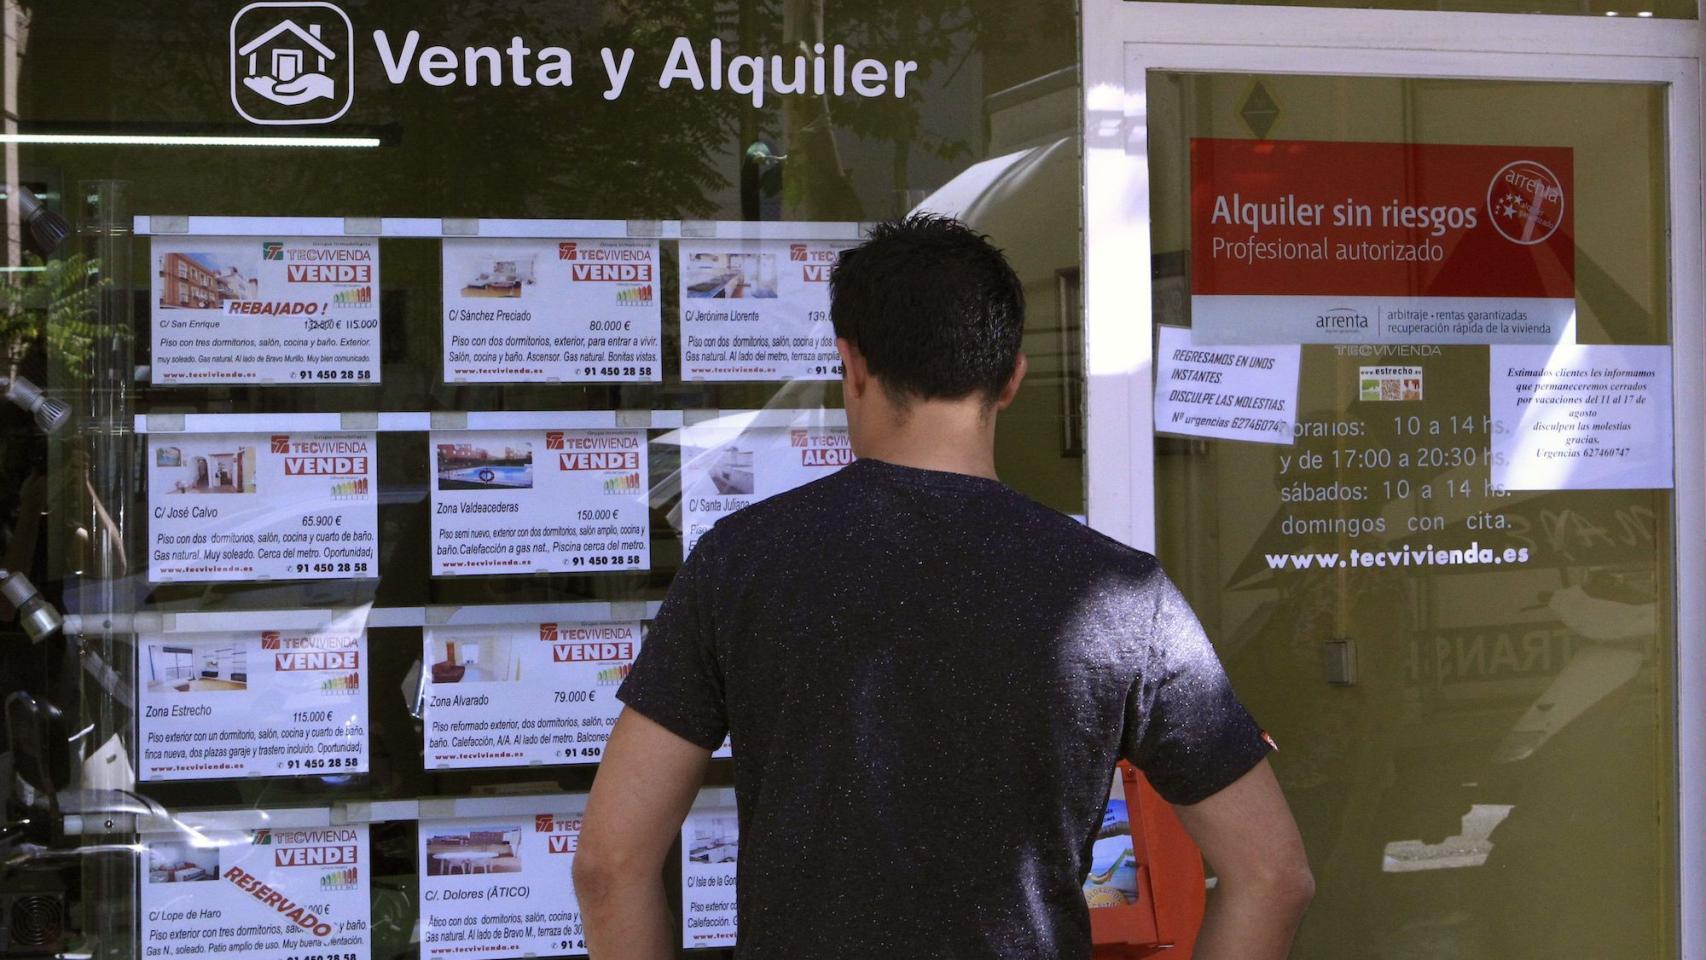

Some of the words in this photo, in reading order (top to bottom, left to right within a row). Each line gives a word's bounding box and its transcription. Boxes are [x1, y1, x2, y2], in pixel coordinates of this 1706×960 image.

[373, 29, 573, 87] Venta
[600, 47, 635, 100] y
[658, 36, 918, 109] Alquiler
[1212, 194, 1323, 233] Alquiler
[1333, 198, 1371, 226] sin
[1382, 200, 1476, 235] riesgos
[287, 249, 370, 261] TECVIVIENDA
[579, 250, 651, 260] TECVIVIENDA
[1213, 236, 1328, 262] Profesional
[1336, 239, 1444, 262] autorizado
[288, 265, 370, 282] VENDE
[573, 265, 650, 280] VENDE
[229, 302, 317, 315] REBAJADO
[460, 309, 494, 321] Sánchez
[496, 310, 531, 321] Preciado
[695, 309, 728, 321] Jerónima
[730, 311, 759, 321] Llorente
[1316, 315, 1367, 327] arrenta
[1387, 309, 1428, 321] arbitraje
[1435, 311, 1464, 320] rentas
[1467, 311, 1528, 323] garantizadas
[172, 320, 187, 328] San
[189, 320, 220, 329] Enrique
[336, 320, 341, 329] €
[346, 319, 377, 329] 115.000
[590, 321, 621, 331] 80.000
[624, 321, 630, 330] €
[1388, 322, 1449, 334] recuperación
[1452, 322, 1482, 334] rápida
[1485, 322, 1497, 333] de
[1500, 322, 1508, 332] la
[1511, 323, 1550, 333] vivienda
[160, 338, 177, 346] Piso
[195, 338, 210, 346] tres
[283, 338, 308, 346] cocina
[316, 338, 337, 346] baño.
[451, 336, 469, 346] Piso
[471, 337, 486, 346] con
[488, 336, 502, 346] dos
[587, 338, 605, 347] para
[607, 336, 631, 345] entrar
[632, 338, 638, 346] a
[640, 336, 658, 345] vivir.
[1334, 344, 1442, 356] TECVIVIENDA
[1173, 349, 1234, 364] REGRESAMOS
[1235, 355, 1248, 366] EN
[1249, 357, 1275, 369] UNOS
[300, 371, 312, 379] 91
[317, 371, 337, 379] 450
[340, 371, 353, 379] 28
[357, 371, 370, 379] 58
[585, 368, 596, 376] 91
[600, 368, 620, 376] 450
[623, 368, 636, 376] 28
[639, 367, 652, 375] 58
[1507, 367, 1552, 376] Estimados
[1555, 368, 1587, 376] clientes
[1590, 368, 1601, 376] les
[1604, 368, 1654, 377] informamos
[1515, 384, 1532, 392] que
[1610, 382, 1646, 390] cerrados
[1169, 390, 1215, 404] DISCULPE
[1215, 394, 1234, 406] LAS
[1516, 397, 1532, 406] por
[1535, 395, 1582, 403] vacaciones
[1585, 395, 1598, 404] del
[1612, 395, 1621, 404] al
[1624, 395, 1634, 404] 17
[1636, 395, 1646, 404] de
[1568, 410, 1596, 418] agosto
[1185, 416, 1229, 427] urgencias
[1394, 416, 1421, 435] 10
[1430, 420, 1440, 435] a
[1451, 416, 1474, 434] 14
[1532, 421, 1574, 432] disculpen
[1577, 422, 1589, 430] las
[1592, 422, 1630, 430] molestias
[567, 437, 638, 448] TECVIVIENDA
[1566, 435, 1599, 444] gracias.
[292, 442, 367, 453] TECVIVIENDA
[1536, 448, 1580, 458] Urgencias
[1583, 448, 1629, 456] 627460747
[286, 457, 367, 475] VENDE
[561, 453, 638, 470] VENDE
[1280, 456, 1291, 474] y
[1299, 451, 1323, 469] de
[1333, 449, 1391, 468] 17:00
[1399, 453, 1409, 467] a
[1418, 448, 1476, 467] 20:30
[1281, 481, 1367, 502] sábados:
[1384, 480, 1409, 498] 10
[1422, 485, 1431, 498] a
[1448, 480, 1471, 498] 14
[167, 507, 189, 519] José
[192, 507, 218, 518] Calvo
[437, 503, 457, 514] Zona
[460, 502, 519, 514] Valdeacederas
[302, 516, 333, 526] 65.900
[335, 516, 342, 526] €
[578, 510, 610, 520] 150.000
[612, 510, 619, 519] €
[1282, 516, 1385, 537] domingos
[1408, 516, 1444, 531] con
[1467, 512, 1512, 530] cita.
[1265, 542, 1529, 569] www.tecvivienda.es
[561, 628, 632, 640] TECVIVIENDA
[283, 637, 358, 648] TECVIVIENDA
[554, 643, 632, 661] VENDE
[276, 652, 358, 671] VENDE
[430, 696, 451, 707] Zona
[454, 695, 488, 706] Alvarado
[554, 691, 587, 702] 79.000
[589, 691, 596, 701] €
[146, 706, 169, 718] Zona
[172, 705, 212, 716] Estrecho
[294, 711, 325, 722] 115.000
[327, 711, 333, 721] €
[275, 830, 357, 844] TECVIVIENDA
[276, 846, 357, 866] VENDE
[443, 889, 484, 900] Dolores
[224, 866, 332, 937] RESERVADO
[162, 911, 183, 922] Lope
[186, 910, 197, 919] de
[200, 909, 221, 919] Haro
